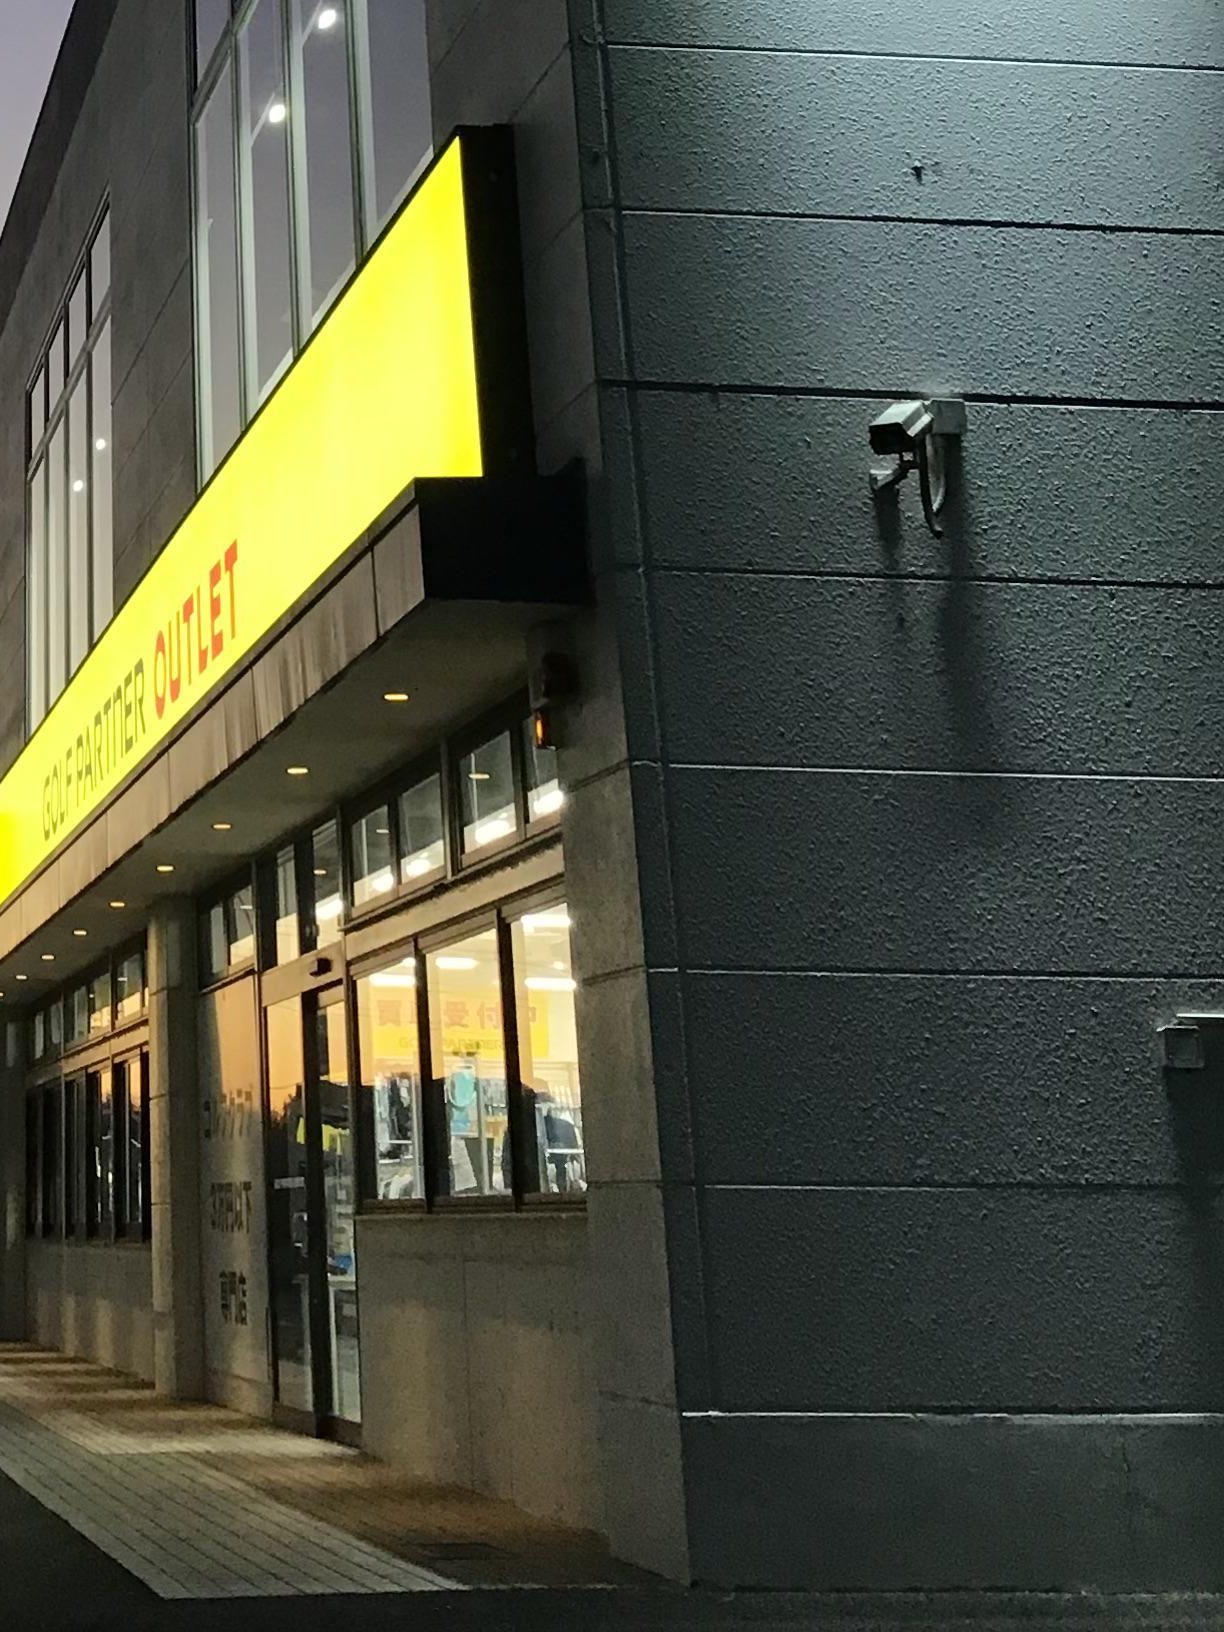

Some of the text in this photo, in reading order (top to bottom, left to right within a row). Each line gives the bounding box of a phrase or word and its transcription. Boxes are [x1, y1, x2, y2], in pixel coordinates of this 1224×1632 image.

[42, 538, 238, 842] GOLF PARTNER OUTLET
